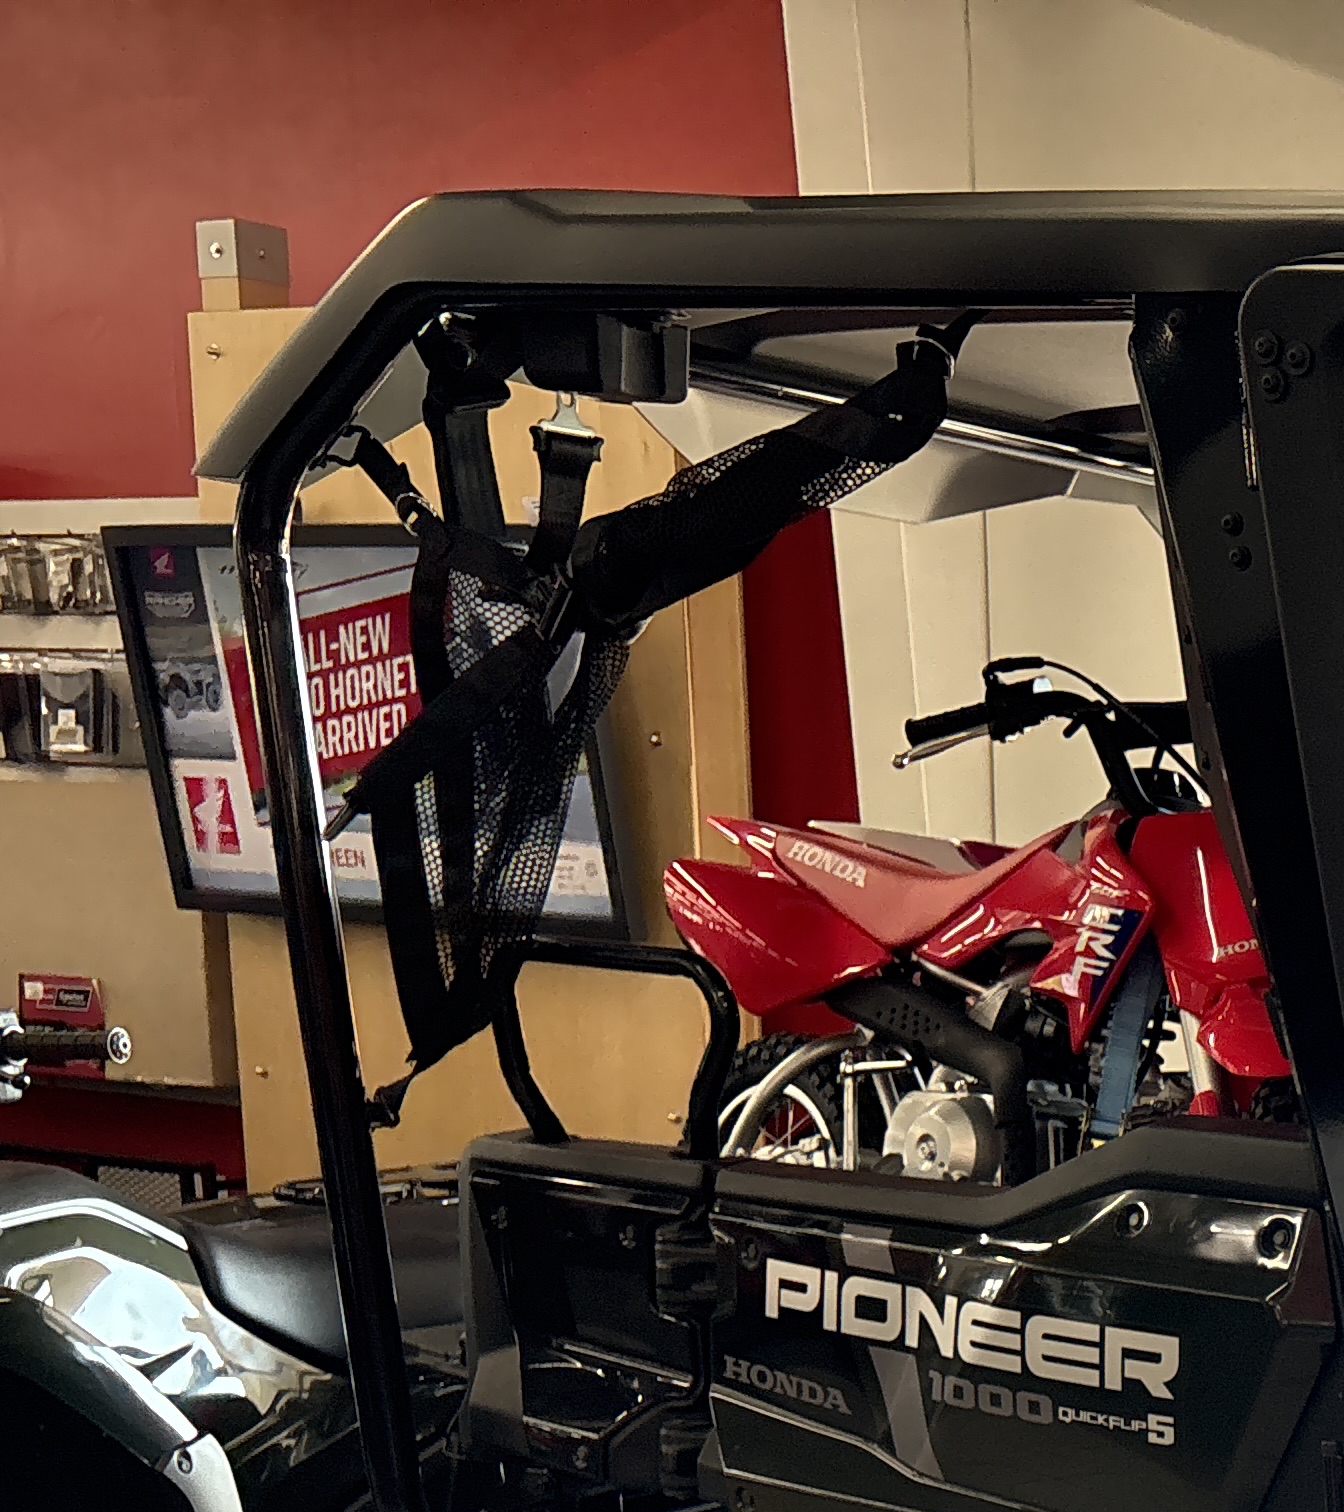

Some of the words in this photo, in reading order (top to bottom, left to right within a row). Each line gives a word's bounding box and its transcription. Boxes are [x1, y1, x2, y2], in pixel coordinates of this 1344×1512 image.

[329, 652, 417, 713] HORNET
[314, 702, 408, 760] ARRIVED
[786, 840, 867, 889] HONDA
[764, 1256, 1181, 1400] PIONEER
[722, 1354, 852, 1416] HONDA
[928, 1368, 1054, 1426] 1000
